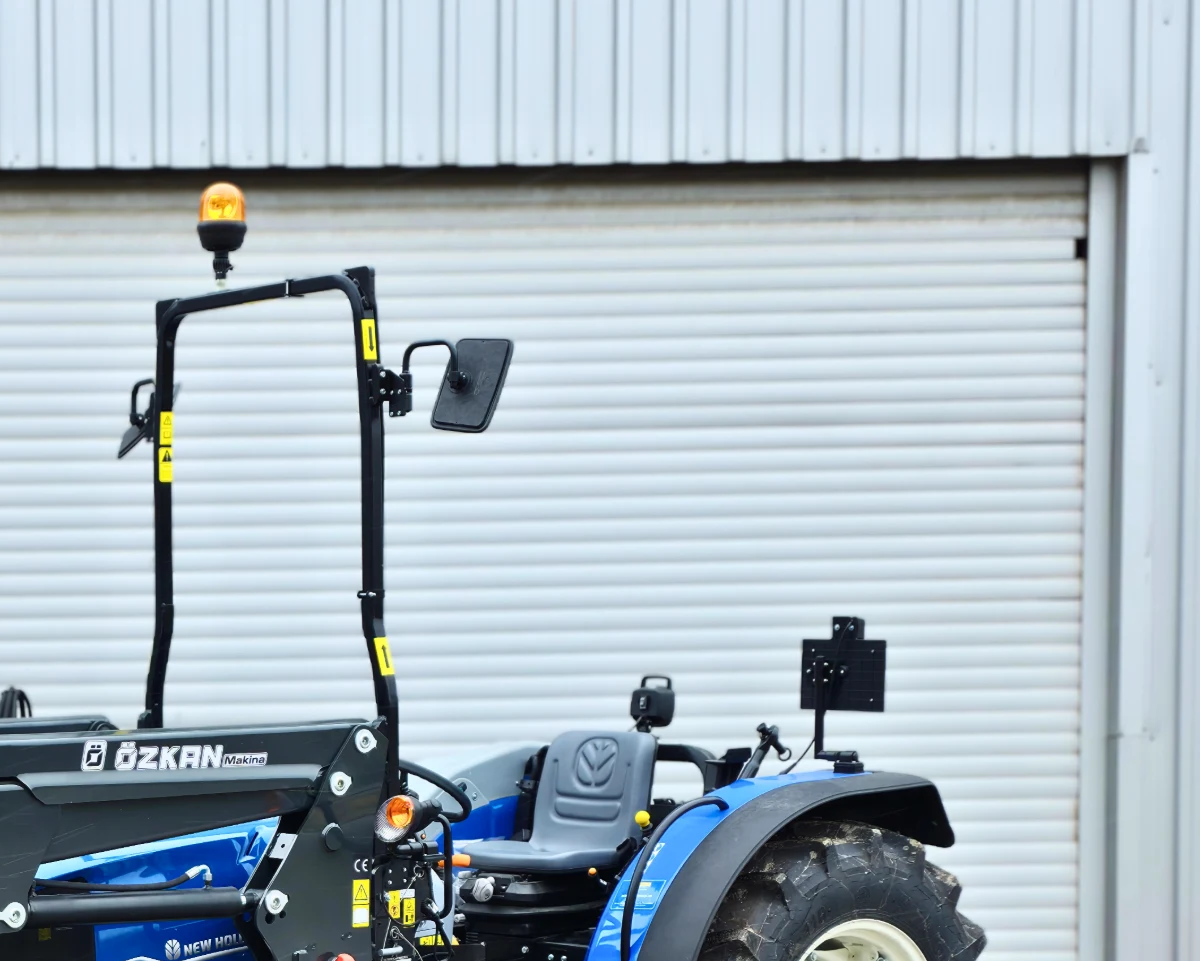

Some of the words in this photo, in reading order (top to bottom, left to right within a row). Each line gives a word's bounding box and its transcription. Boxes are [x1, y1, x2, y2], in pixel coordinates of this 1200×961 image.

[114, 741, 224, 771] ÖZKAN
[224, 754, 266, 766] Makina
[183, 938, 212, 957] NEW
[214, 933, 245, 949] HOLL
